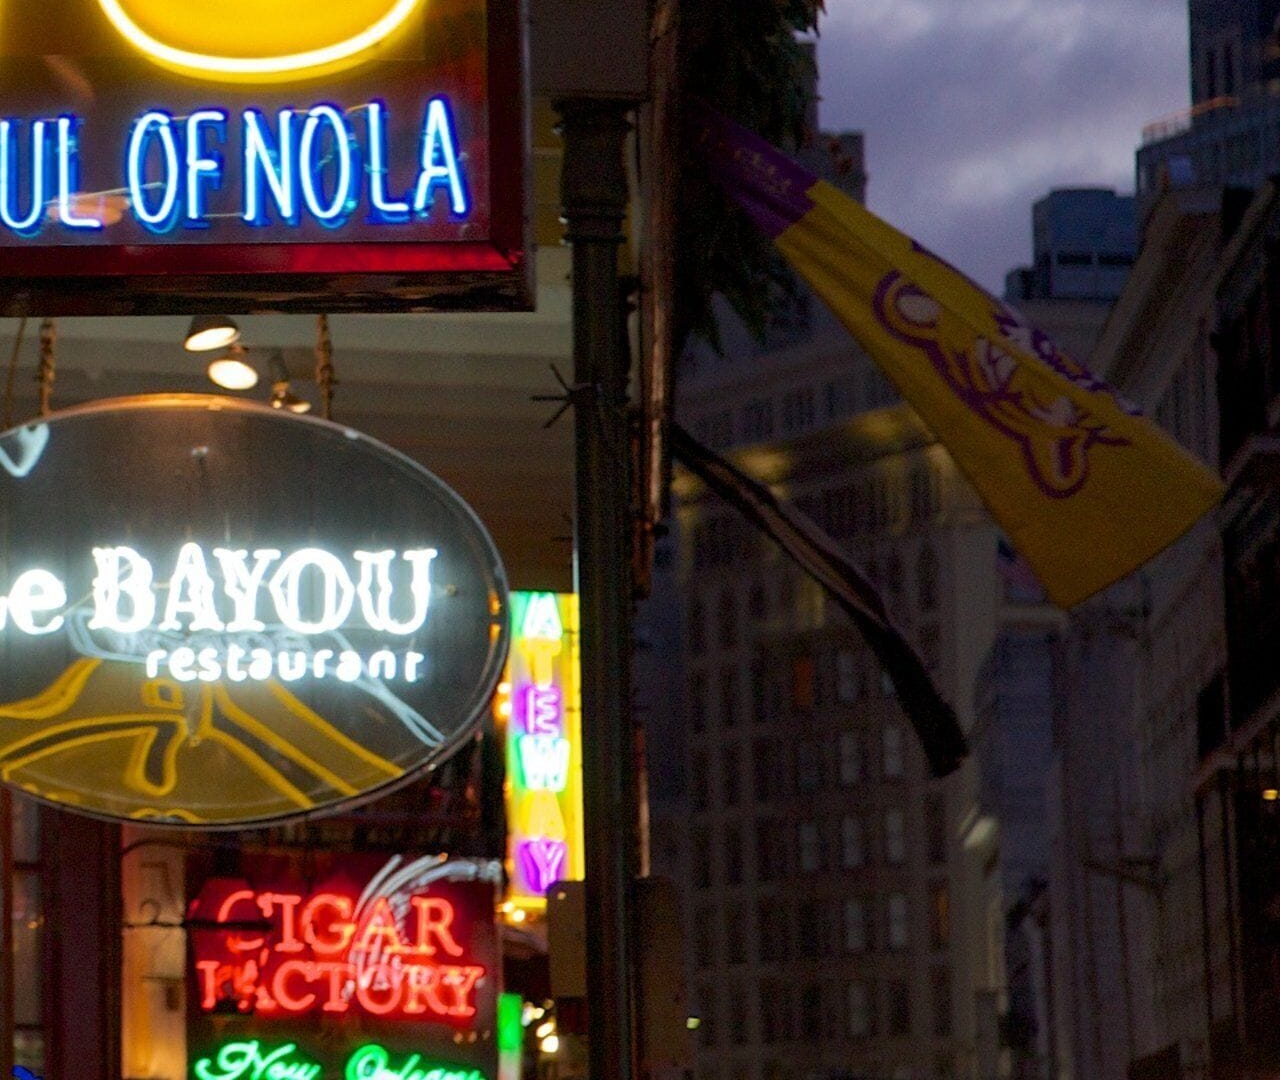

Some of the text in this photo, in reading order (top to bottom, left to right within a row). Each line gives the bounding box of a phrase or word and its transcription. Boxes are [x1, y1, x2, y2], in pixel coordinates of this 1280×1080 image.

[128, 110, 225, 223] OF
[243, 99, 466, 221] NOLA
[87, 540, 439, 635] BAYOU
[145, 643, 426, 684] restaurant
[218, 889, 464, 958] CIGAR
